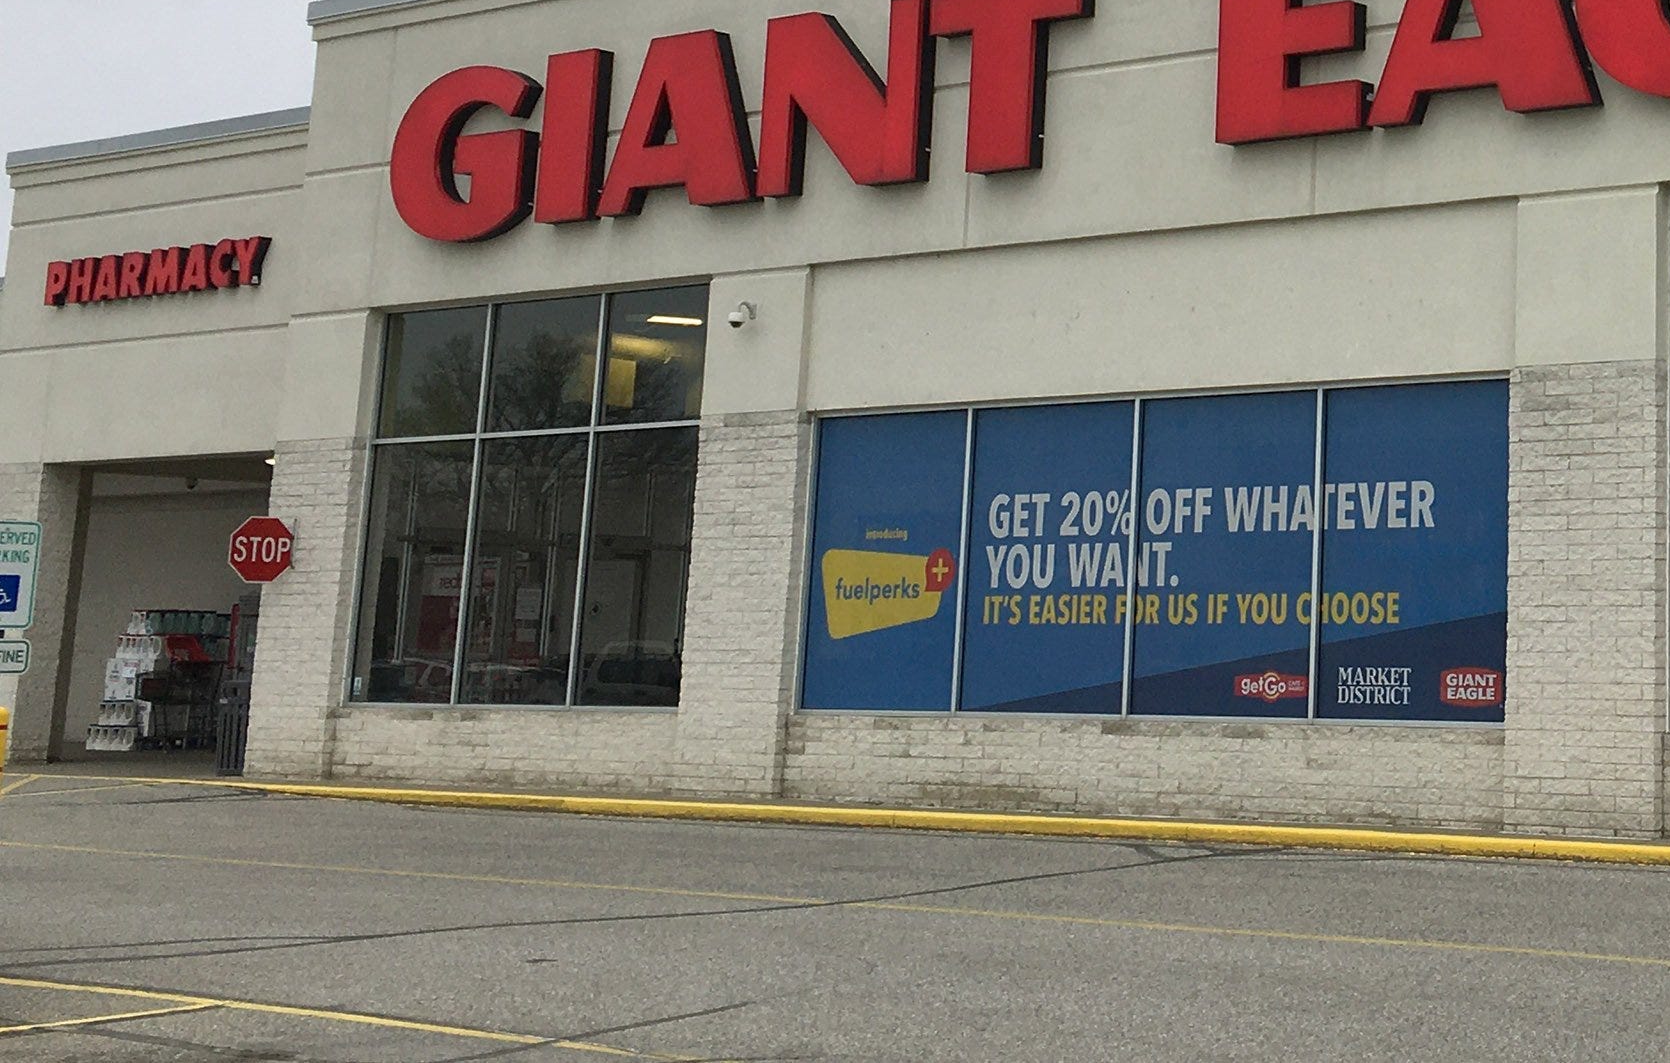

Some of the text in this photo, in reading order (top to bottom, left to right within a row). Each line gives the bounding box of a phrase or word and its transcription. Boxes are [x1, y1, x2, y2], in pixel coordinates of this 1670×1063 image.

[44, 236, 272, 307] PHARMACY
[988, 480, 1435, 538] GET 20% OFF WHATEVER
[0, 550, 30, 563] KING
[233, 535, 291, 563] STOP
[985, 543, 1056, 589] YOU
[835, 576, 921, 605] fuelperks
[983, 594, 1022, 625] IT'S
[1029, 593, 1108, 625] EASIER
[1167, 592, 1199, 626] US
[1207, 593, 1229, 625] IF
[1236, 592, 1288, 625] YOU
[1240, 675, 1287, 696] getGo
[1337, 667, 1412, 686] MARKET
[1446, 673, 1497, 687] GIANT
[1337, 686, 1411, 705] DISTRICT
[1446, 687, 1496, 700] EAGLE
